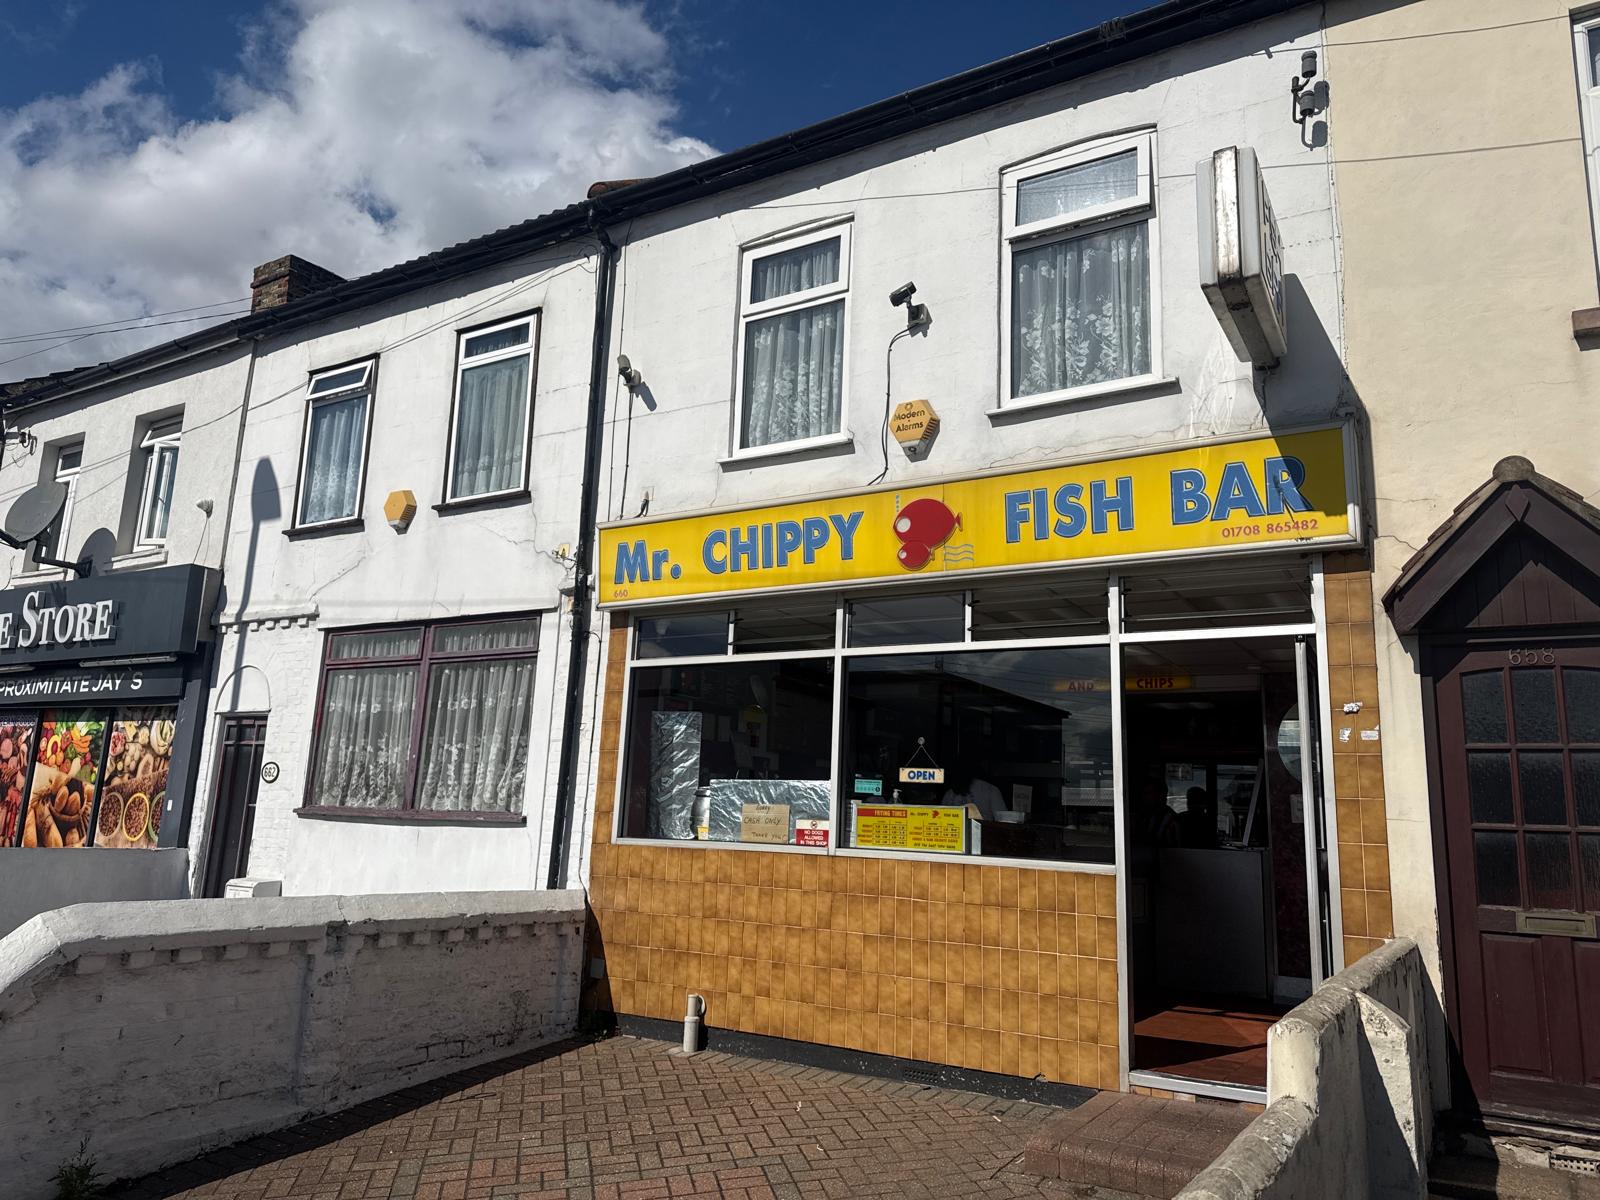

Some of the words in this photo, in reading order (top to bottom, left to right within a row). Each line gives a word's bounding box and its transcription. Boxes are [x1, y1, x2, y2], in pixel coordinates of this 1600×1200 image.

[894, 410, 925, 421] Modern
[896, 421, 924, 432] Alarms
[614, 540, 682, 584] Mr.
[702, 511, 865, 574] CHIPPY
[1005, 476, 1135, 544] FISH
[1170, 456, 1314, 525] BAR
[1222, 524, 1260, 538] 01708
[1266, 519, 1318, 533] 865482
[614, 589, 628, 598] 660
[18, 589, 113, 647] STORE
[1508, 648, 1555, 665] 658
[1068, 680, 1094, 691] AND
[1136, 678, 1174, 689] CHIPS
[908, 771, 935, 781] OPEN
[744, 816, 760, 824] CASH
